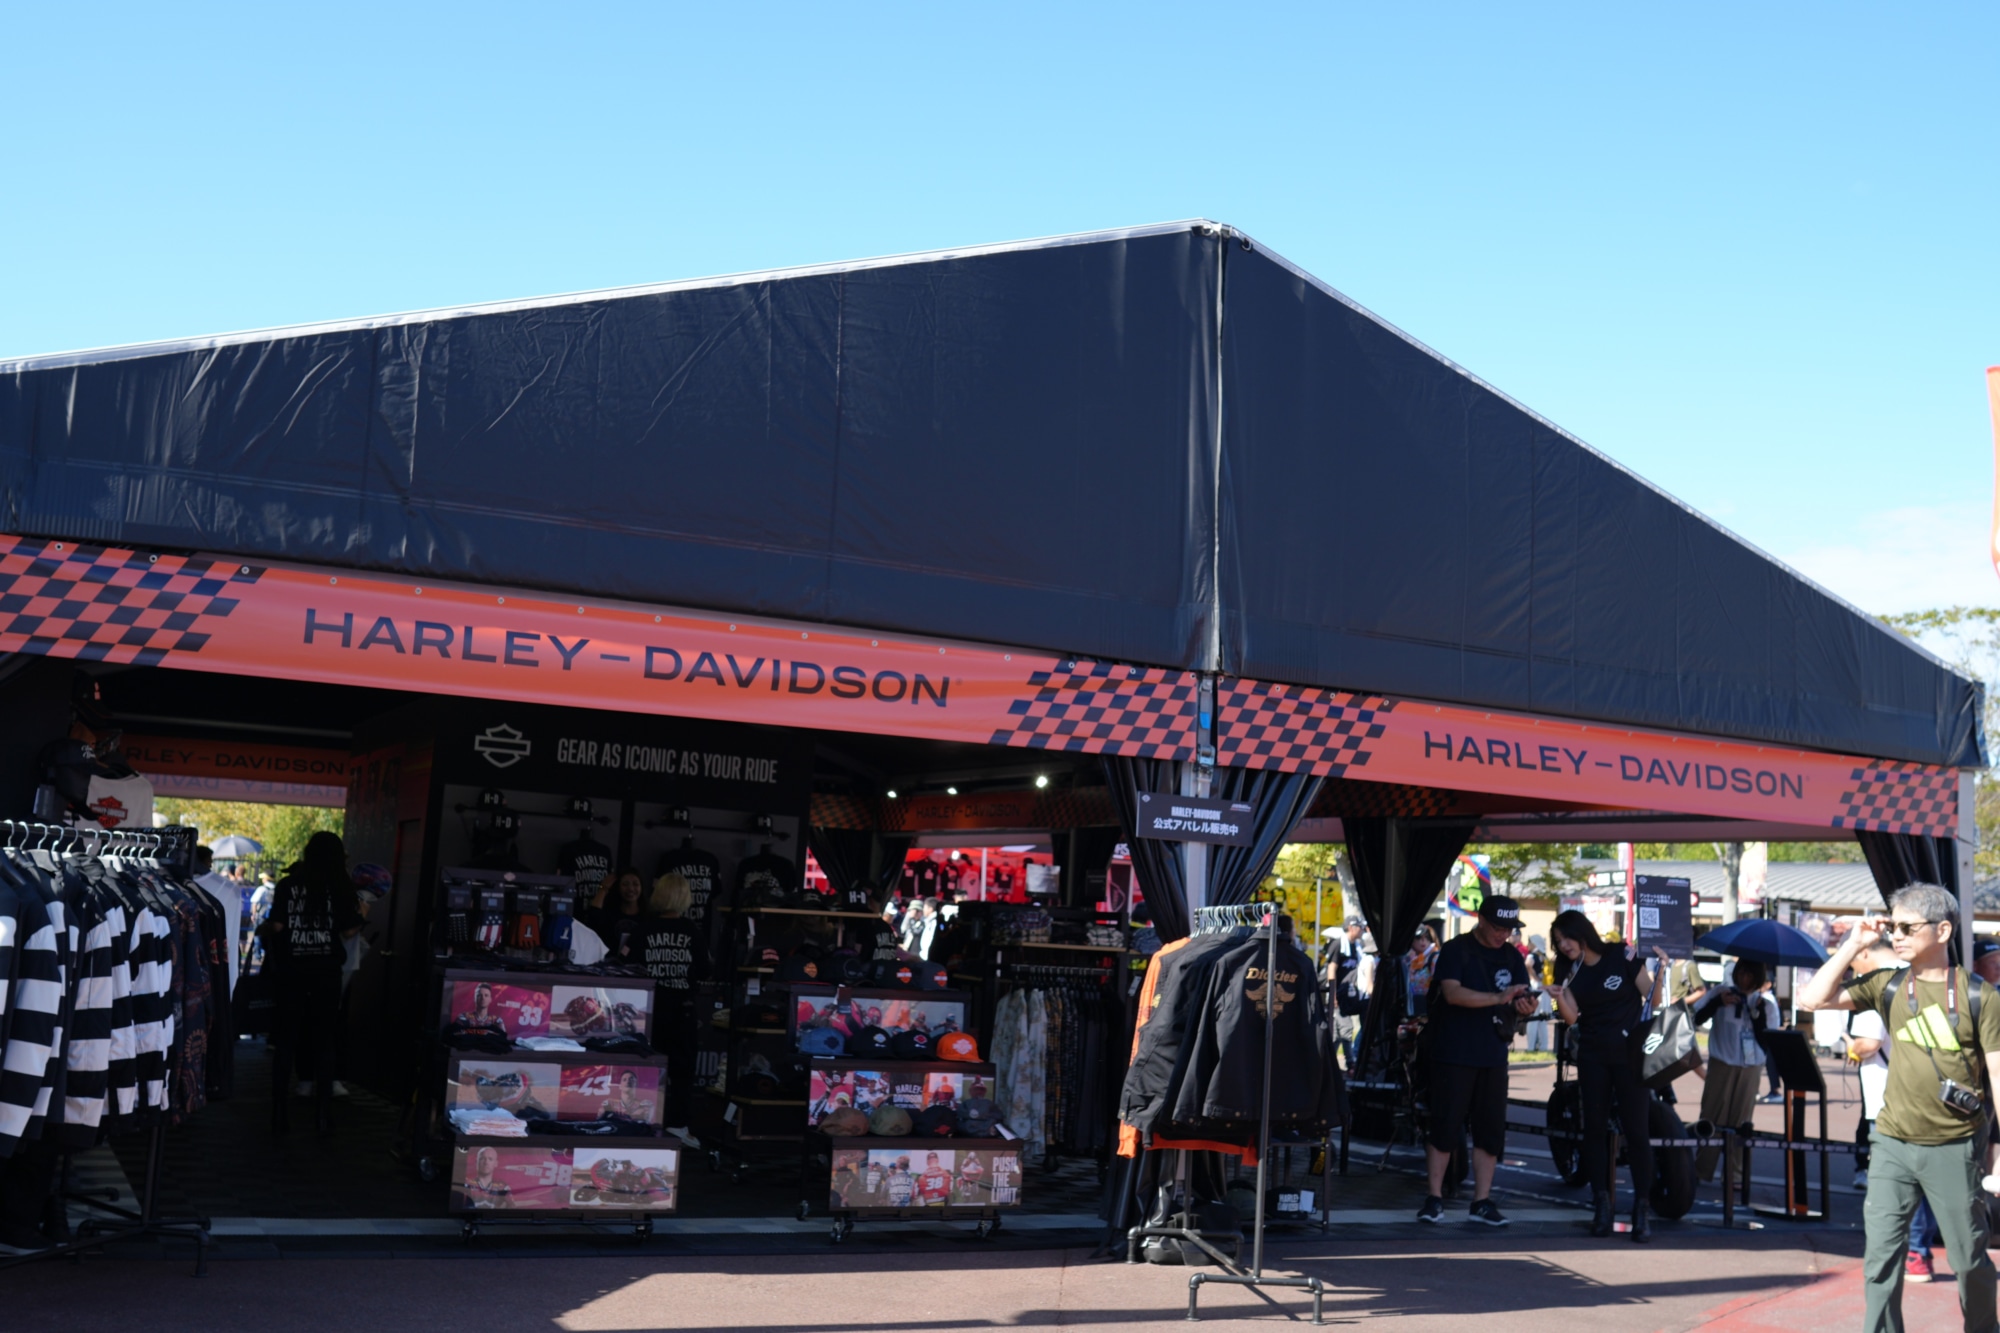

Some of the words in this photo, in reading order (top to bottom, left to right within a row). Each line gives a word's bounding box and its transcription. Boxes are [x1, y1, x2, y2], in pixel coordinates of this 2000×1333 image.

[303, 607, 950, 708] HARLEY-DAVIDSON
[126, 747, 345, 775] RLEY-DAVIDSON
[557, 738, 597, 766] GEAR
[601, 743, 622, 769] AS
[625, 744, 676, 774] ICONIC
[679, 750, 699, 776] AS
[703, 752, 742, 780] YOUR
[745, 756, 778, 784] RIDE
[1424, 730, 1803, 800] HARLEY-DAVIDSON
[1153, 817, 1239, 836] 公式アパレル販売中
[291, 929, 332, 945] RACING
[645, 948, 693, 963] DAVIDSON
[647, 963, 690, 978] FACTORY
[518, 1004, 543, 1027] 33
[578, 1074, 612, 1096] 43
[538, 1161, 573, 1186] 38
[925, 1176, 944, 1191] 38
[992, 1172, 1010, 1188] THE
[991, 1187, 1019, 1204] LIMIT
